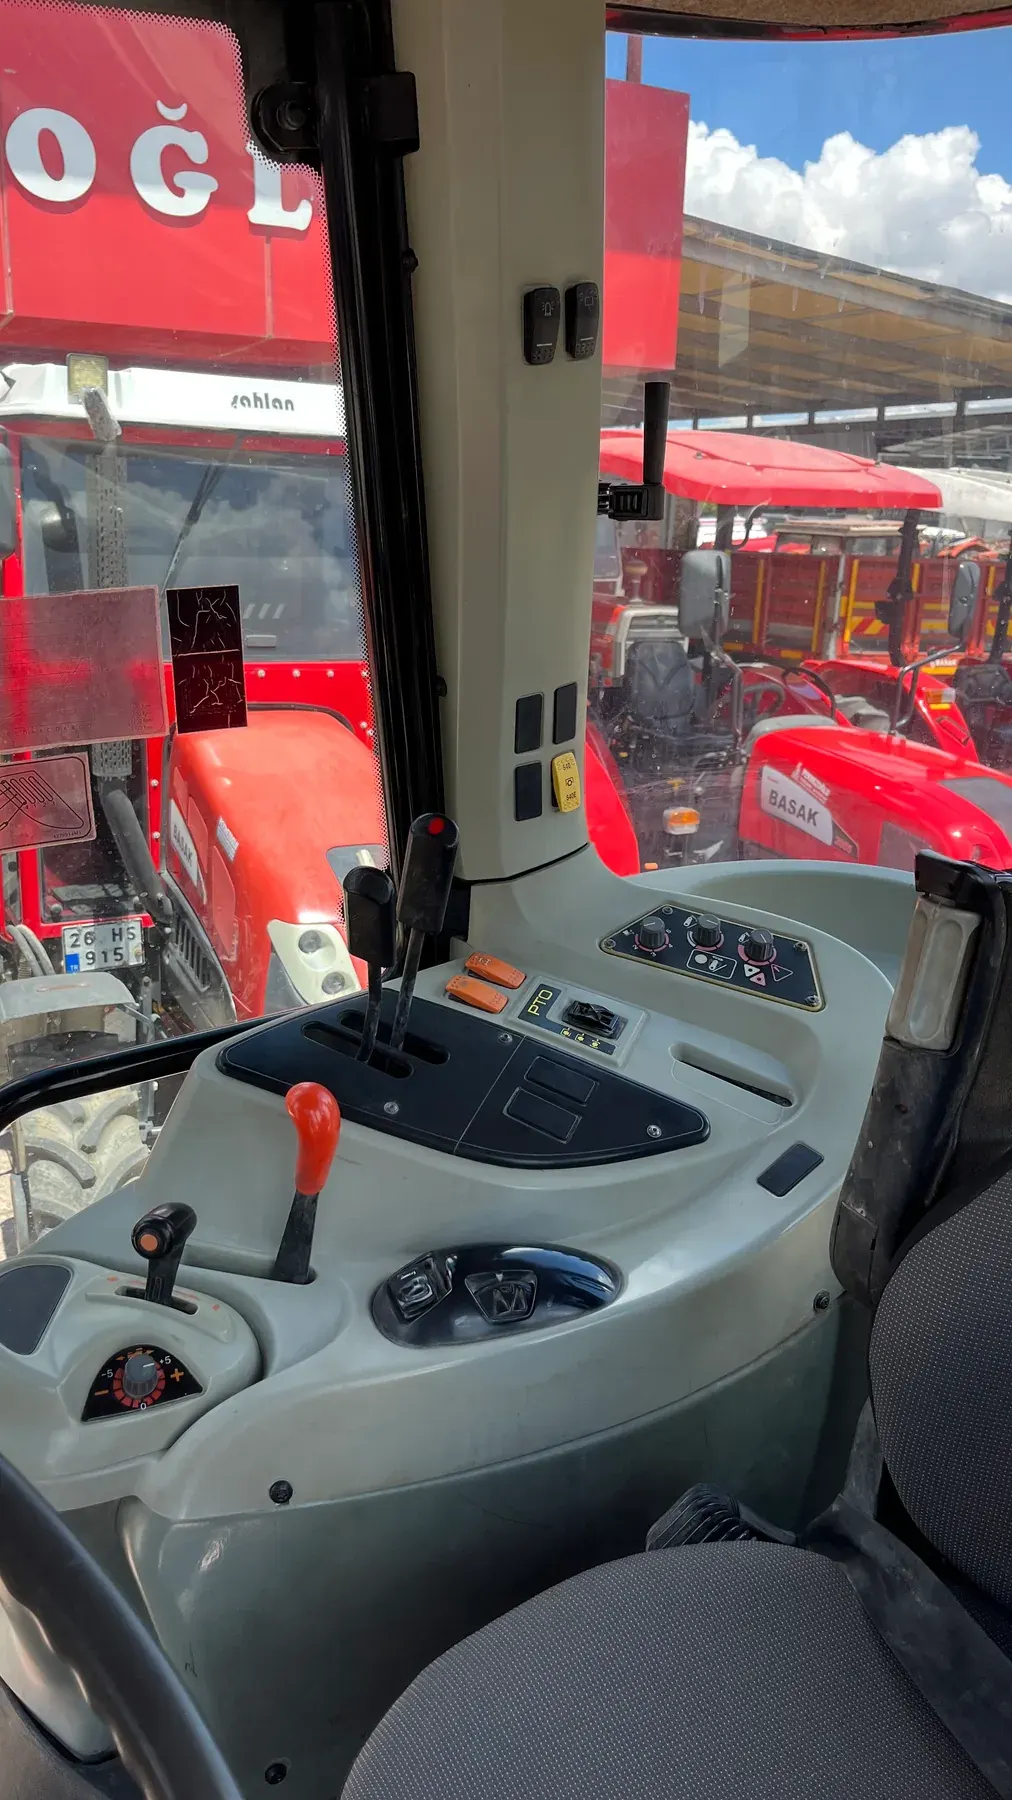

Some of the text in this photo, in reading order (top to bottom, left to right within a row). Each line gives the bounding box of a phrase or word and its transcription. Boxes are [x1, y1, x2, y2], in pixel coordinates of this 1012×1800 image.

[769, 789, 819, 827] BASAK
[69, 926, 136, 948] 26 HS
[85, 947, 124, 966] 915
[527, 989, 553, 1016] PTO
[140, 1402, 147, 1410] 0
